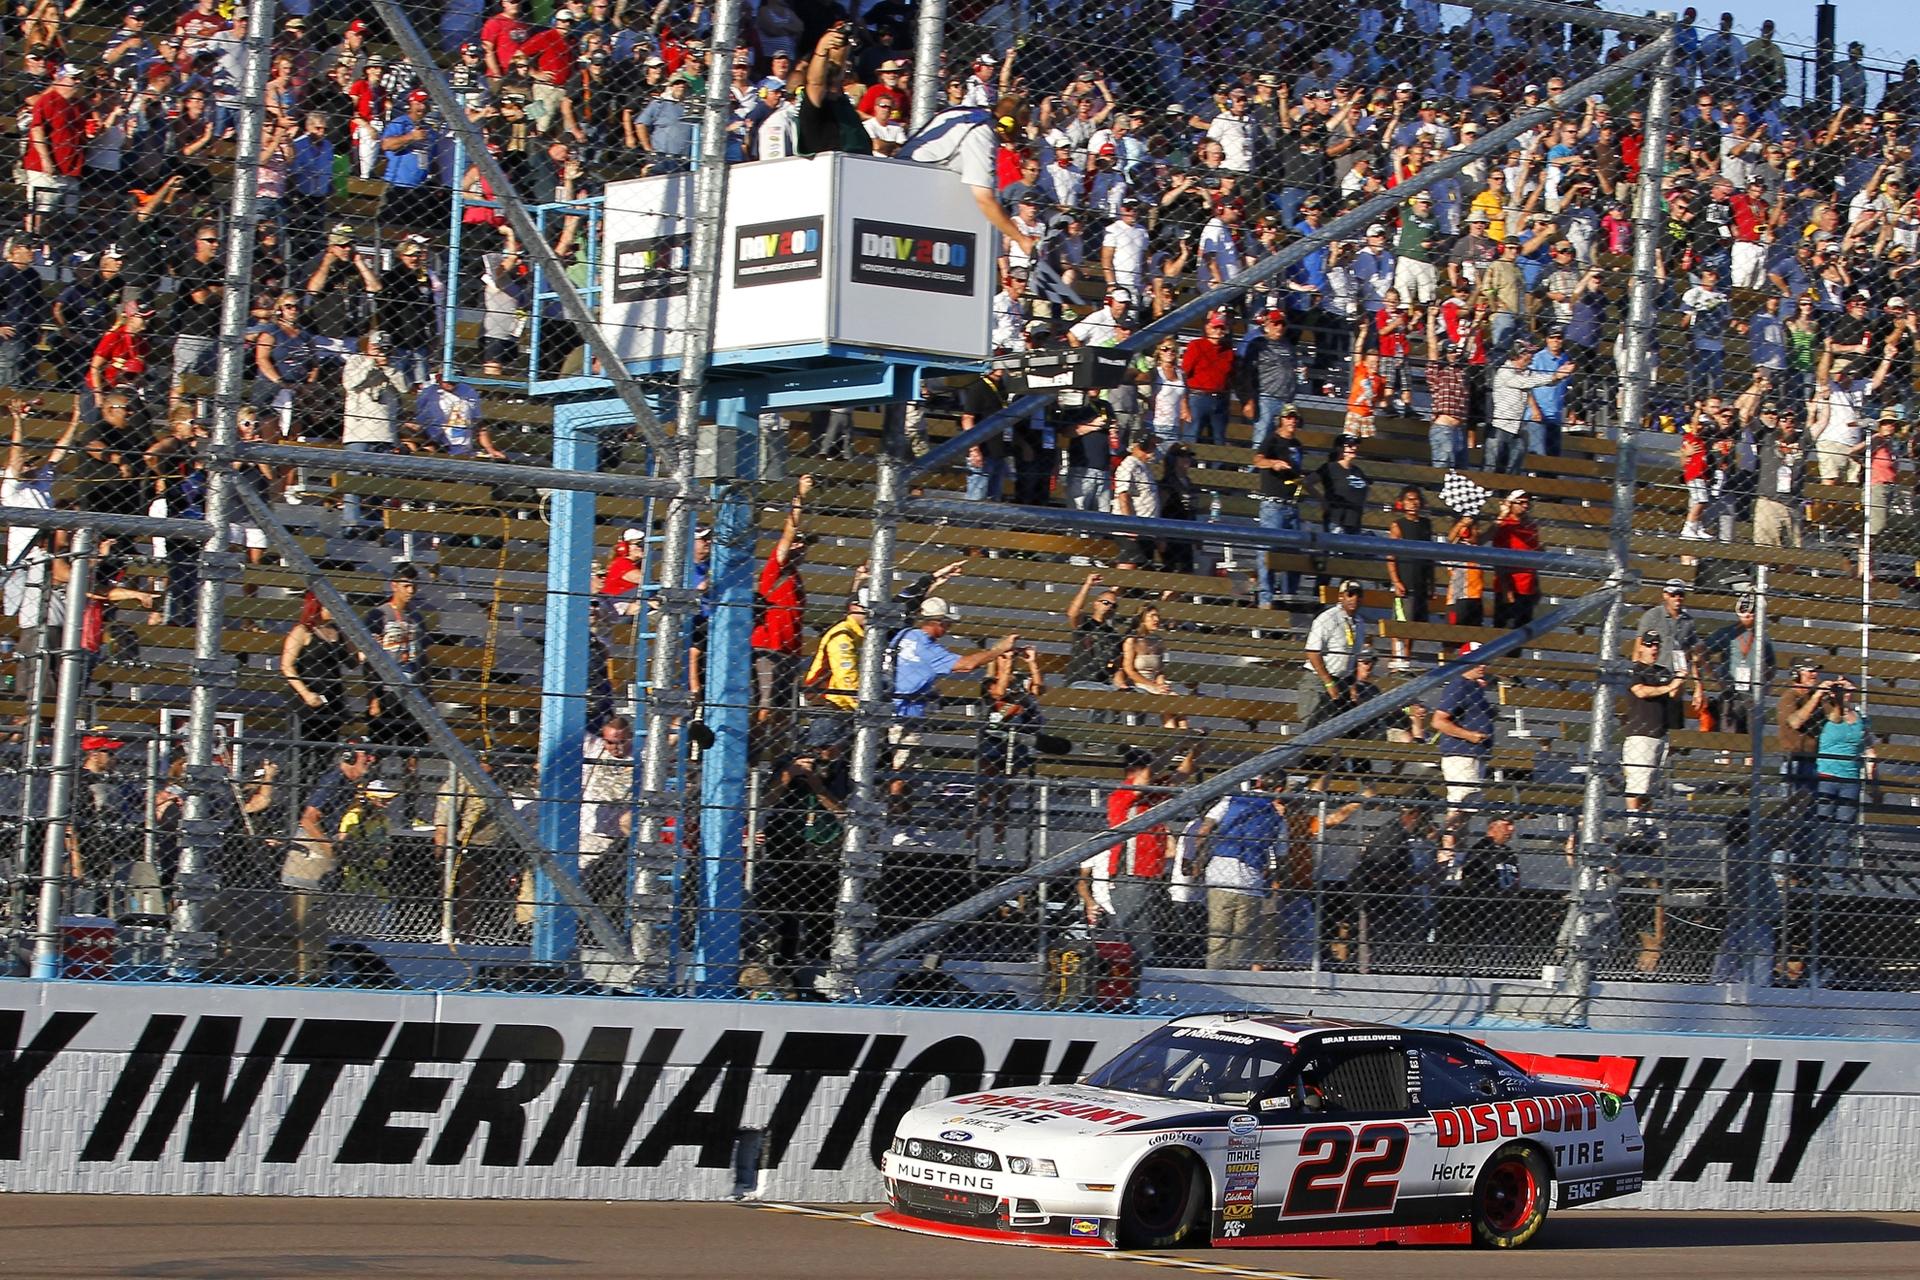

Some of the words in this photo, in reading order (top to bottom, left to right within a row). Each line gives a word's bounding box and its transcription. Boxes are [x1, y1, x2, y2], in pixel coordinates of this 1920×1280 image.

[1321, 1036, 1345, 1045] BRAD
[1347, 1034, 1401, 1042] KESELOWSKI
[951, 1094, 1148, 1126] DISCOUNT
[967, 1107, 1060, 1125] TIRE
[1429, 1092, 1597, 1148] DISCOUNT
[941, 1130, 972, 1141] Ford
[1227, 1150, 1261, 1162] MAHLE
[1554, 1140, 1604, 1168] TIRE
[898, 1162, 994, 1190] MUSTANG
[1227, 1163, 1258, 1173] MOOG
[1278, 1122, 1409, 1221] 22
[1432, 1163, 1476, 1182] Hertz
[1567, 1181, 1604, 1200] SKF
